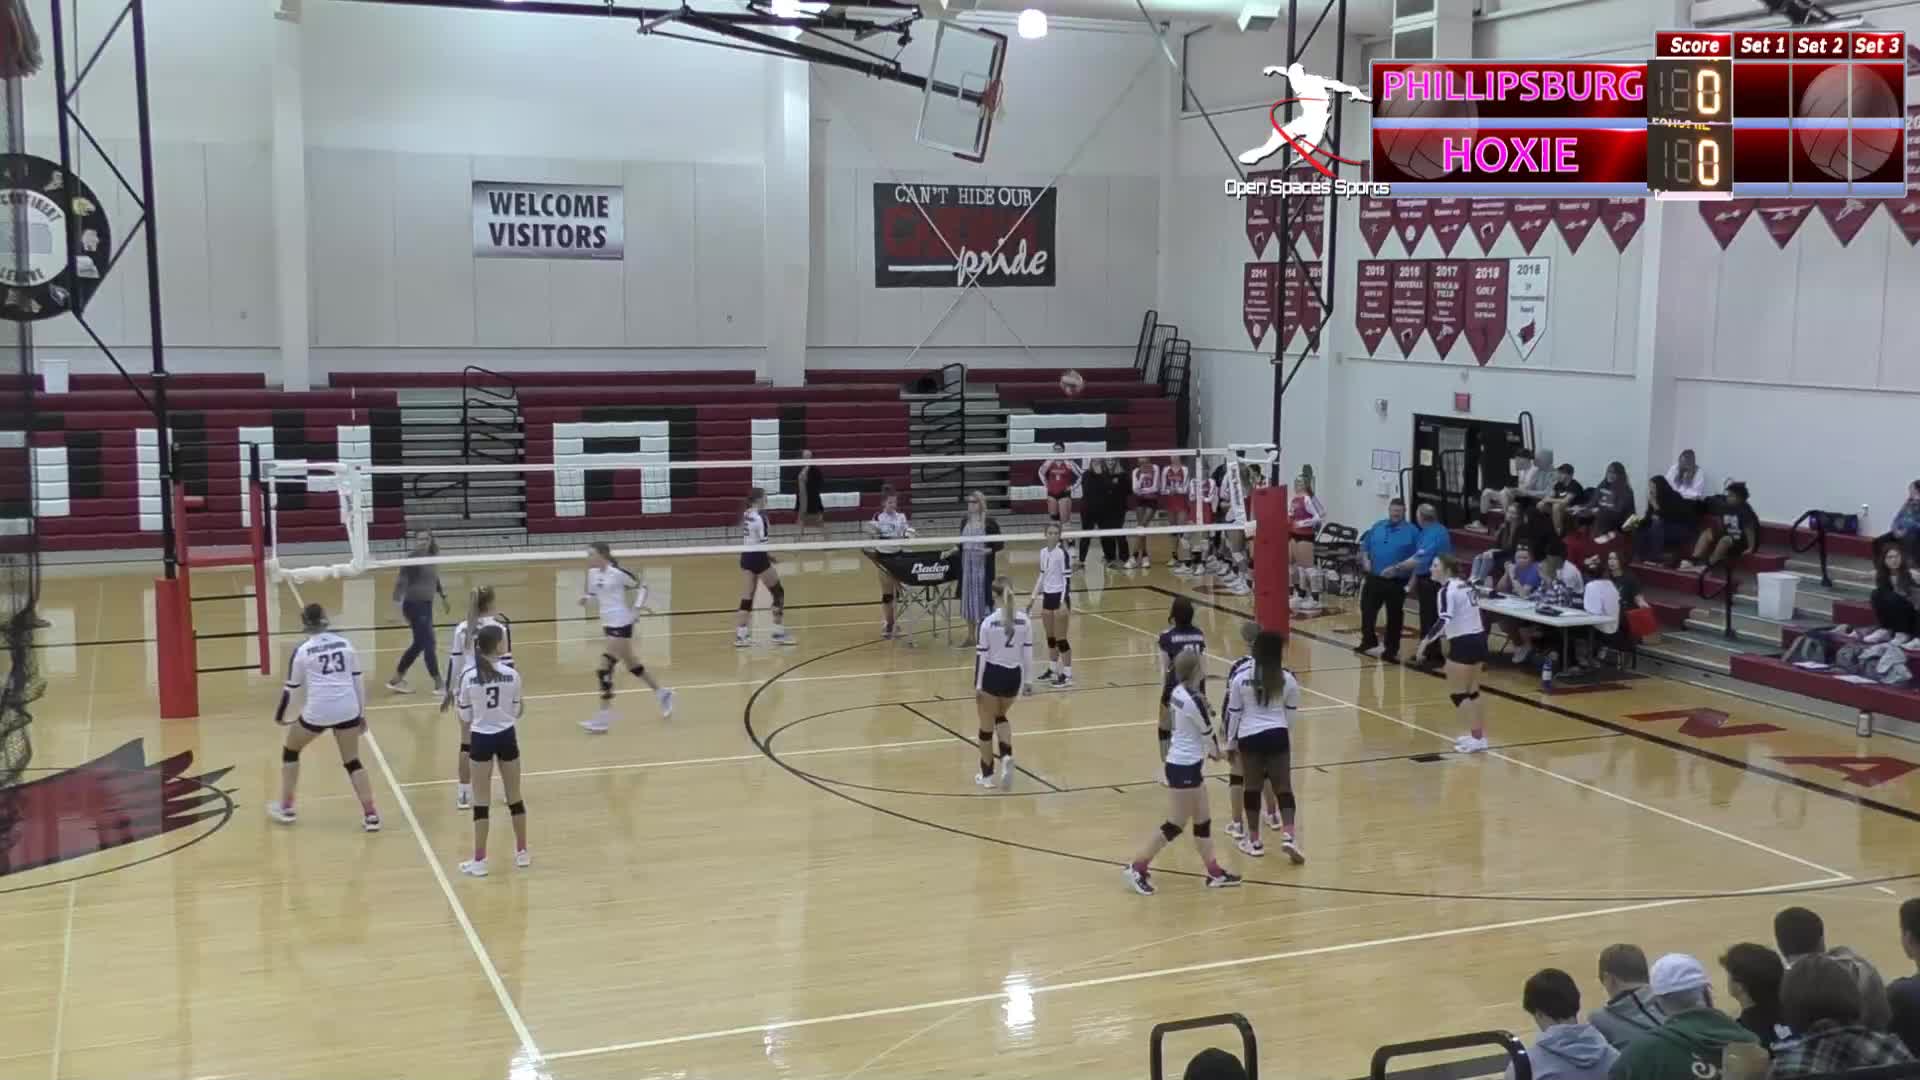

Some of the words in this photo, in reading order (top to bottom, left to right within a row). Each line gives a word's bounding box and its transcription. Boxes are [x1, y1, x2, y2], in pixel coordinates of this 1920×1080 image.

[489, 191, 609, 218] WELCOME
[895, 186, 949, 205] CAN'T
[958, 187, 995, 206] HIDE
[998, 187, 1033, 207] OUR
[488, 222, 608, 249] VISITORS
[955, 238, 1048, 286] pride
[1365, 265, 1385, 277] 2015
[1435, 265, 1458, 277] 2017
[1517, 264, 1541, 275] 2018
[911, 561, 950, 575] Baden
[318, 651, 346, 676] 23
[486, 686, 499, 709] 3
